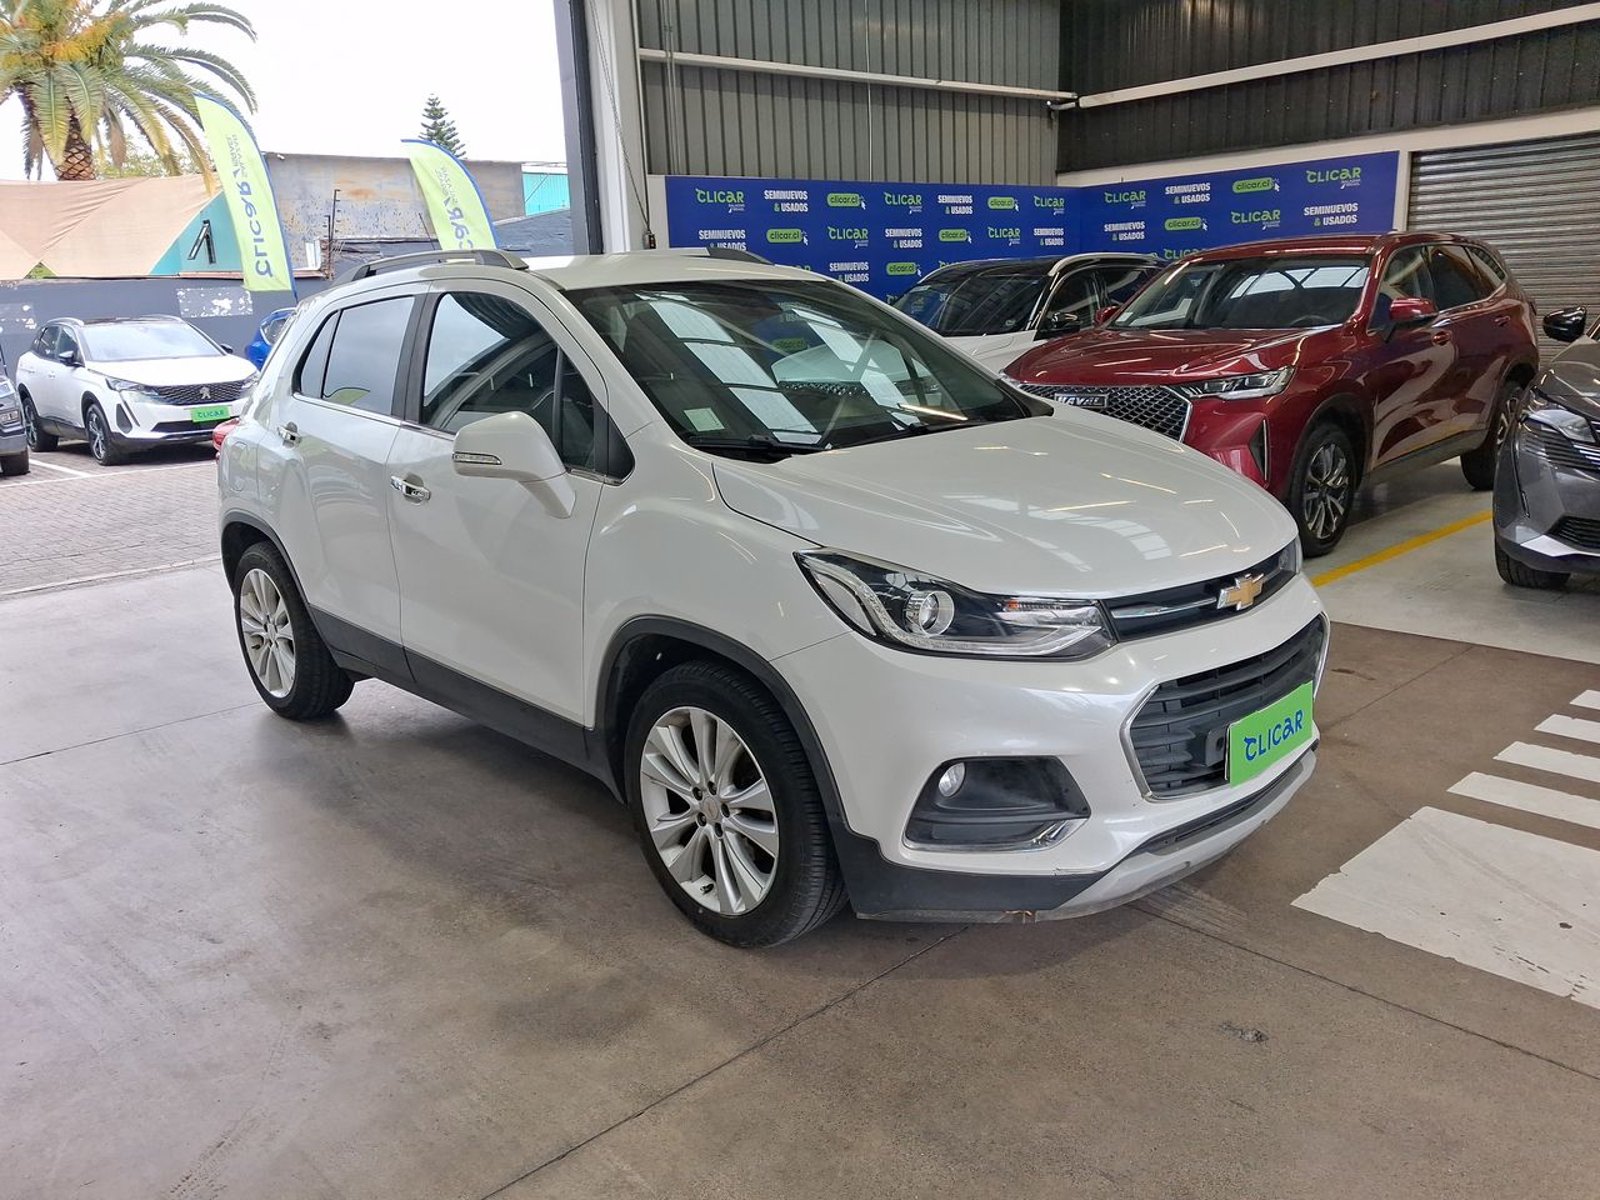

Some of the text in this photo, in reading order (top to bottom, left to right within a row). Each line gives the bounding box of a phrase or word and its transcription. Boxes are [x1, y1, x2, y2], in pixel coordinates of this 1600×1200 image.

[1165, 182, 1211, 195] SEMINUEVOS
[1237, 180, 1270, 191] clicar.cl
[764, 190, 808, 200] SEMINUEVOS
[830, 194, 859, 204] clicar.cl
[938, 195, 973, 204] SEMINUEVOS
[1181, 193, 1210, 203] USADOS
[781, 203, 808, 212] USADOS
[951, 206, 973, 215] USADOS
[1304, 203, 1358, 216] SEMINUEVOS
[1168, 219, 1200, 229] clicar.cl
[1323, 214, 1358, 226] USADOS
[1104, 220, 1145, 232] SEMINUEVOS
[699, 229, 746, 240] SEMINUEVOS
[770, 230, 800, 240] clicar.cl
[885, 228, 922, 238] SEMINUEVOS
[1118, 231, 1145, 241] USADOS
[899, 240, 922, 248] USADOS
[1045, 237, 1064, 245] USADOS
[829, 262, 869, 272] SEMINUEVOS
[844, 273, 869, 282] USADOS
